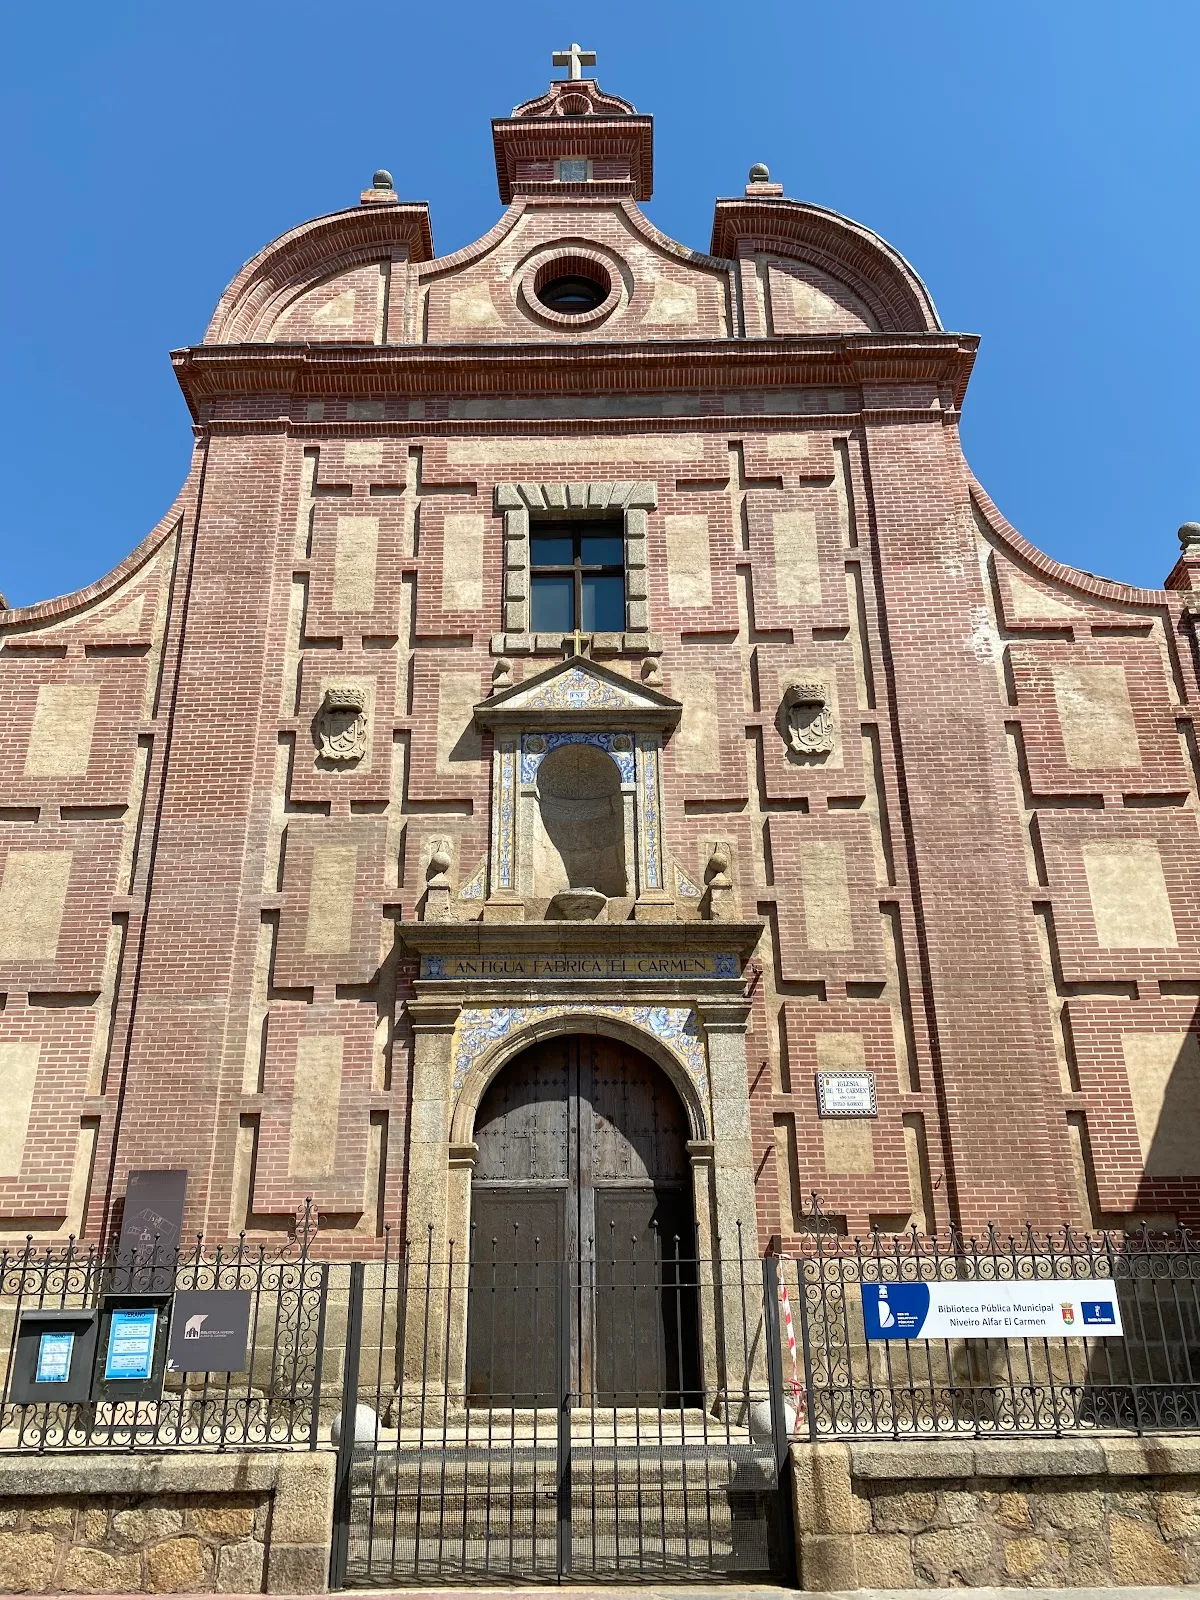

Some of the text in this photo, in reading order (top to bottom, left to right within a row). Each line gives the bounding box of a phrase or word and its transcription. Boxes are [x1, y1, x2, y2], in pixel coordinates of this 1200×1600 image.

[455, 960, 525, 974] ANTIGUA
[534, 958, 602, 974] FABRICA
[938, 1303, 1054, 1314] Biblioteca Pública Municipal
[949, 1317, 1046, 1327] Niveiro Alfar El Carmen
